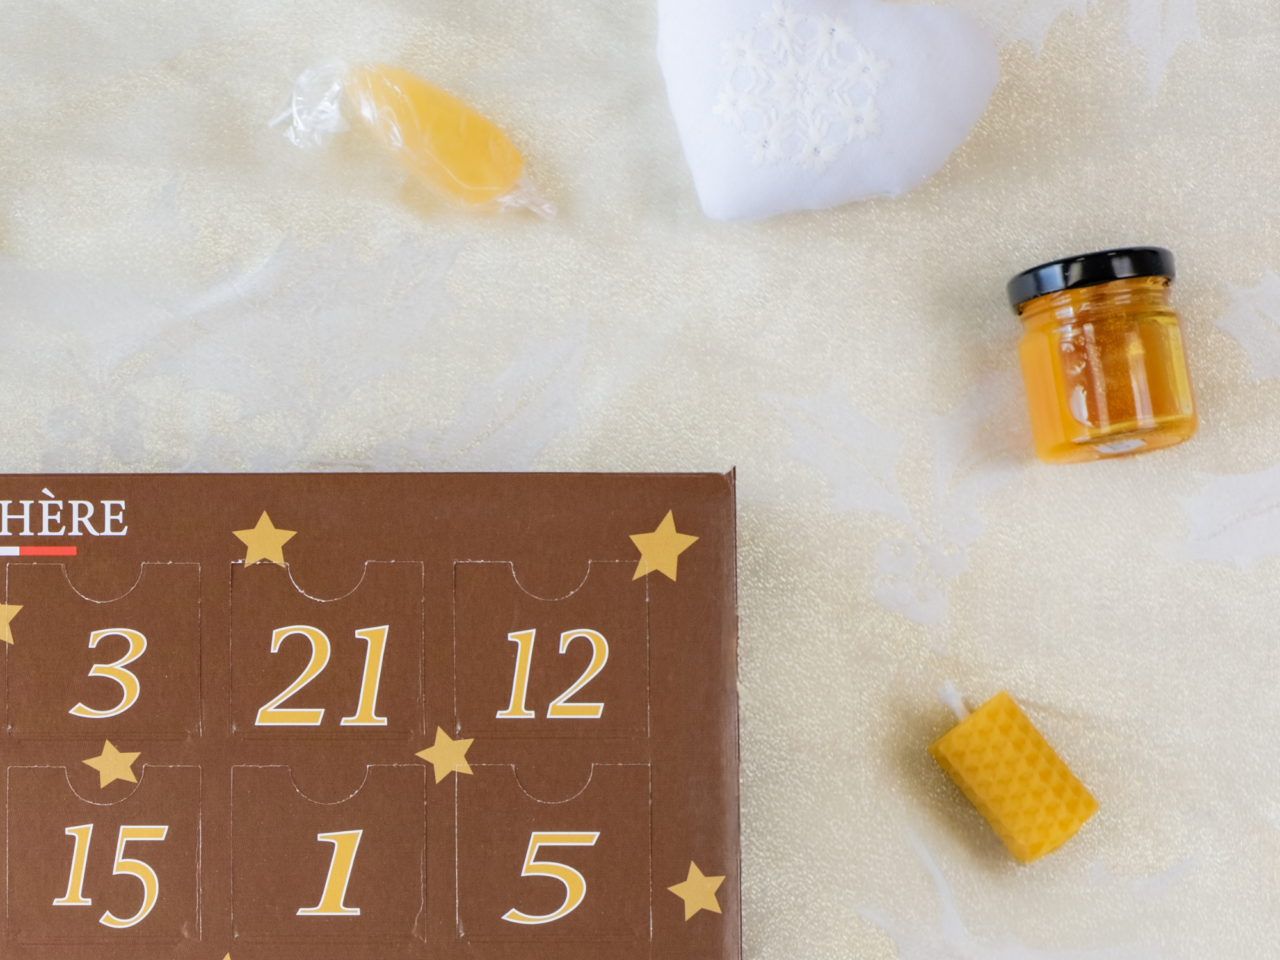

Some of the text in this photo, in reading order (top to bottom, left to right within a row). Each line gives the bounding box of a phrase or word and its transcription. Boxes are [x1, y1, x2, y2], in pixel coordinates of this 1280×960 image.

[69, 627, 147, 719] 3
[255, 624, 389, 726] 21
[496, 628, 609, 719] 12
[52, 823, 169, 929] 15
[296, 829, 363, 916] 1
[501, 831, 600, 925] 5
